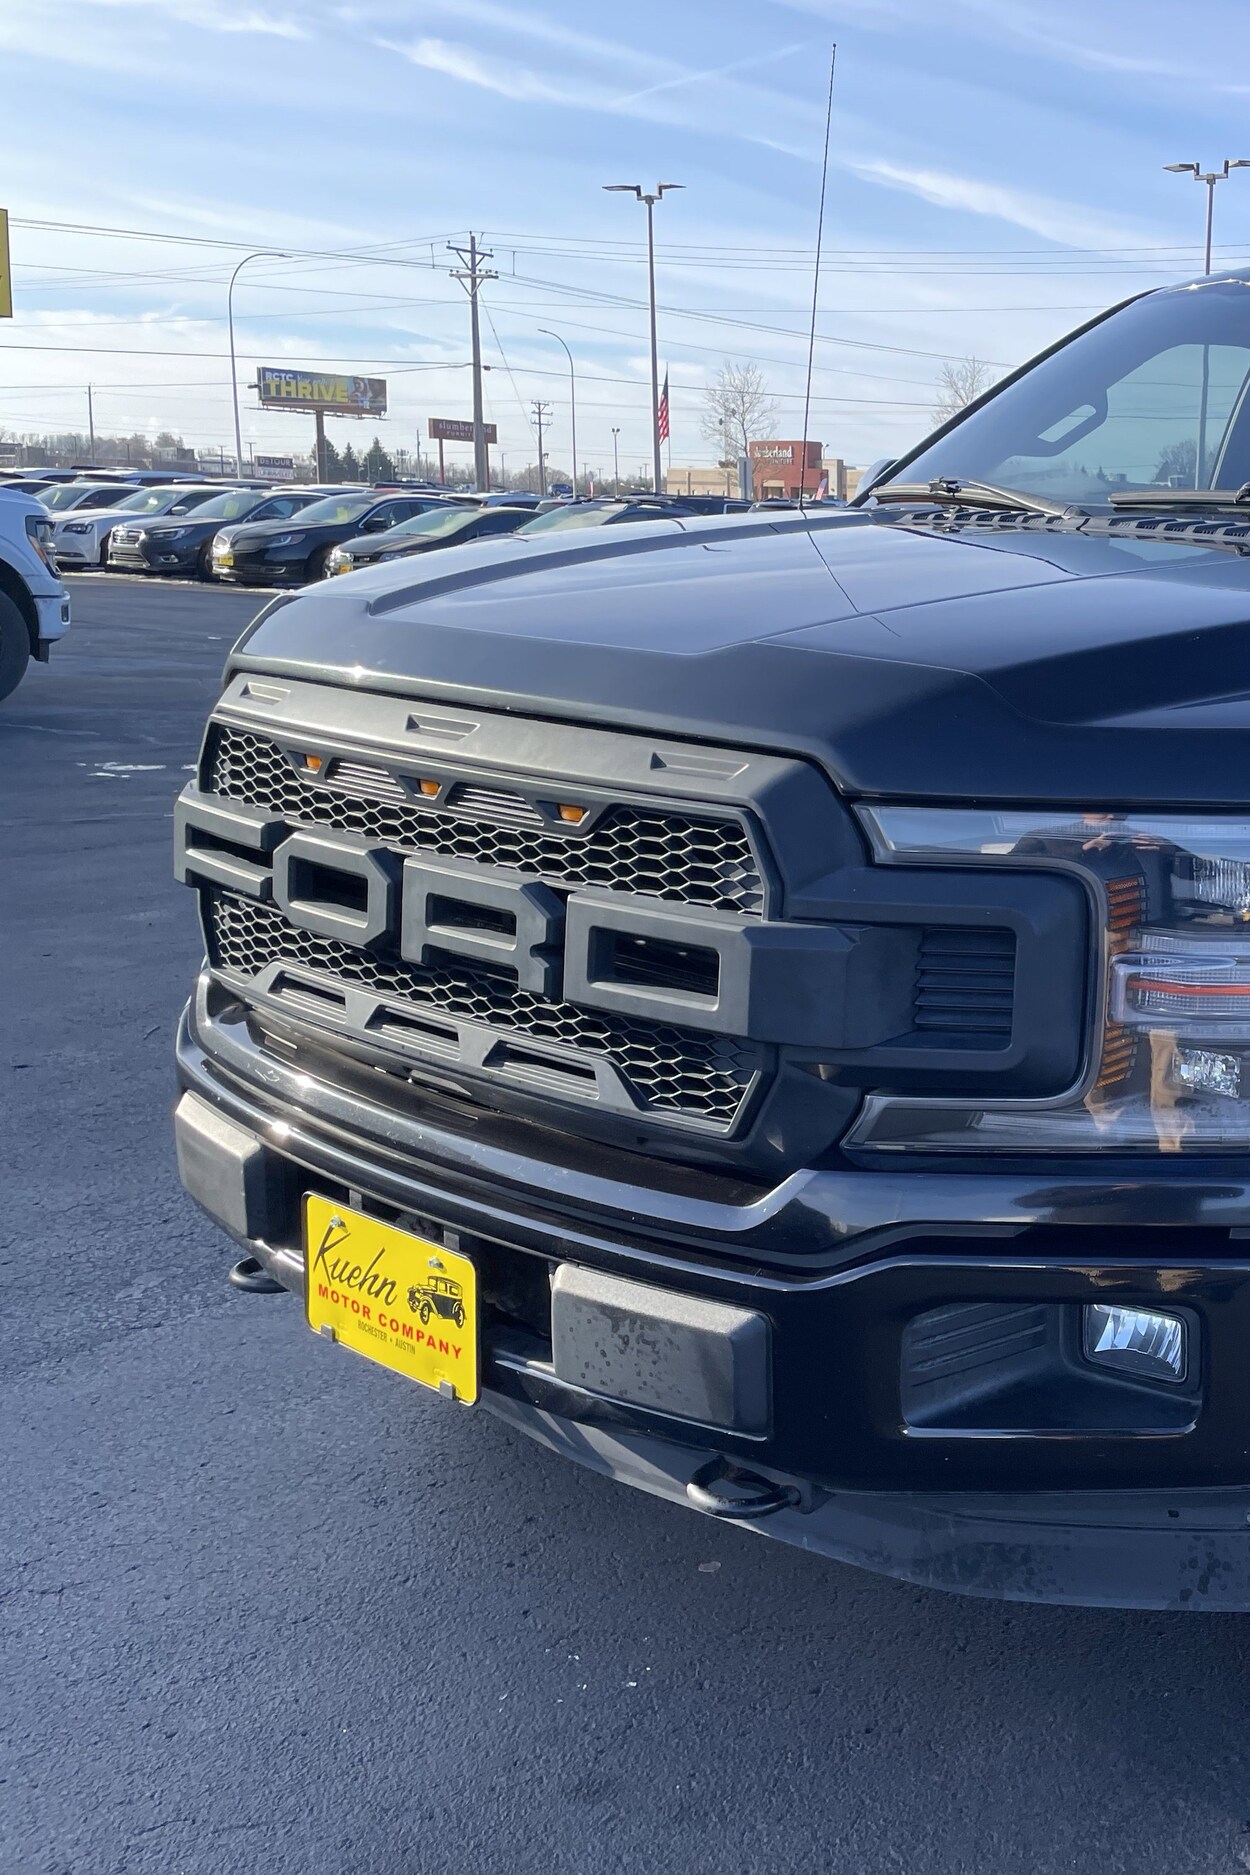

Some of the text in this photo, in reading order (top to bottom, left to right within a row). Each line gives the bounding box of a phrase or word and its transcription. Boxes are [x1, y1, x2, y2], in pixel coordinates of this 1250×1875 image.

[265, 371, 294, 381] RCTC
[439, 420, 492, 434] slumbernd
[260, 457, 291, 467] DETOUR
[173, 787, 756, 1037] FORD
[313, 1225, 398, 1306] Kuehn
[317, 1283, 462, 1360] MOTOR COMPANY
[357, 1320, 416, 1355] ROCHESTER AUSTIN
